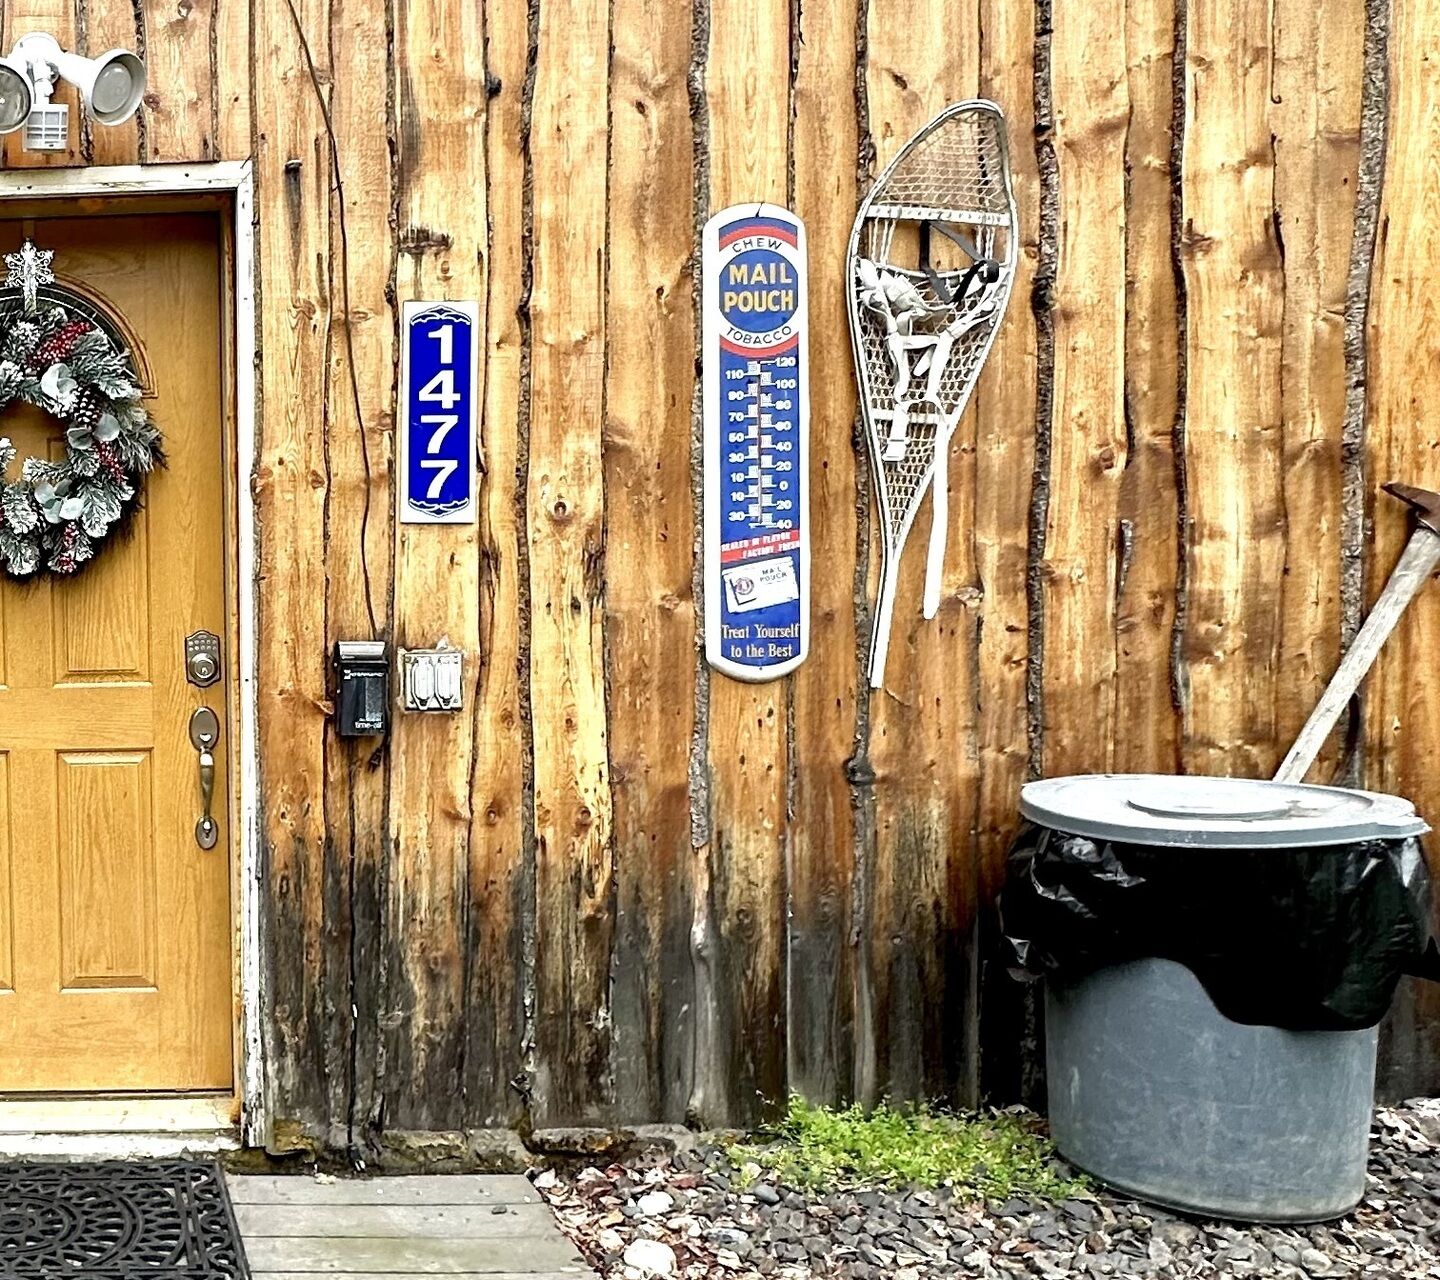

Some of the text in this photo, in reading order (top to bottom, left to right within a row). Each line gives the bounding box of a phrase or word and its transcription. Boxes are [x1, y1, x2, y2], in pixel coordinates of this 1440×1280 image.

[732, 238, 782, 253] CHEW
[729, 263, 792, 285] MAIL
[724, 289, 793, 313] POUCH
[726, 326, 791, 344] TOBACCO
[725, 369, 744, 379] 110
[418, 325, 461, 499] 1477
[728, 412, 744, 422] 70
[730, 473, 745, 482] 10
[730, 492, 745, 501] 10
[721, 622, 800, 639] Treat Yourself
[731, 643, 793, 658] to the Best
